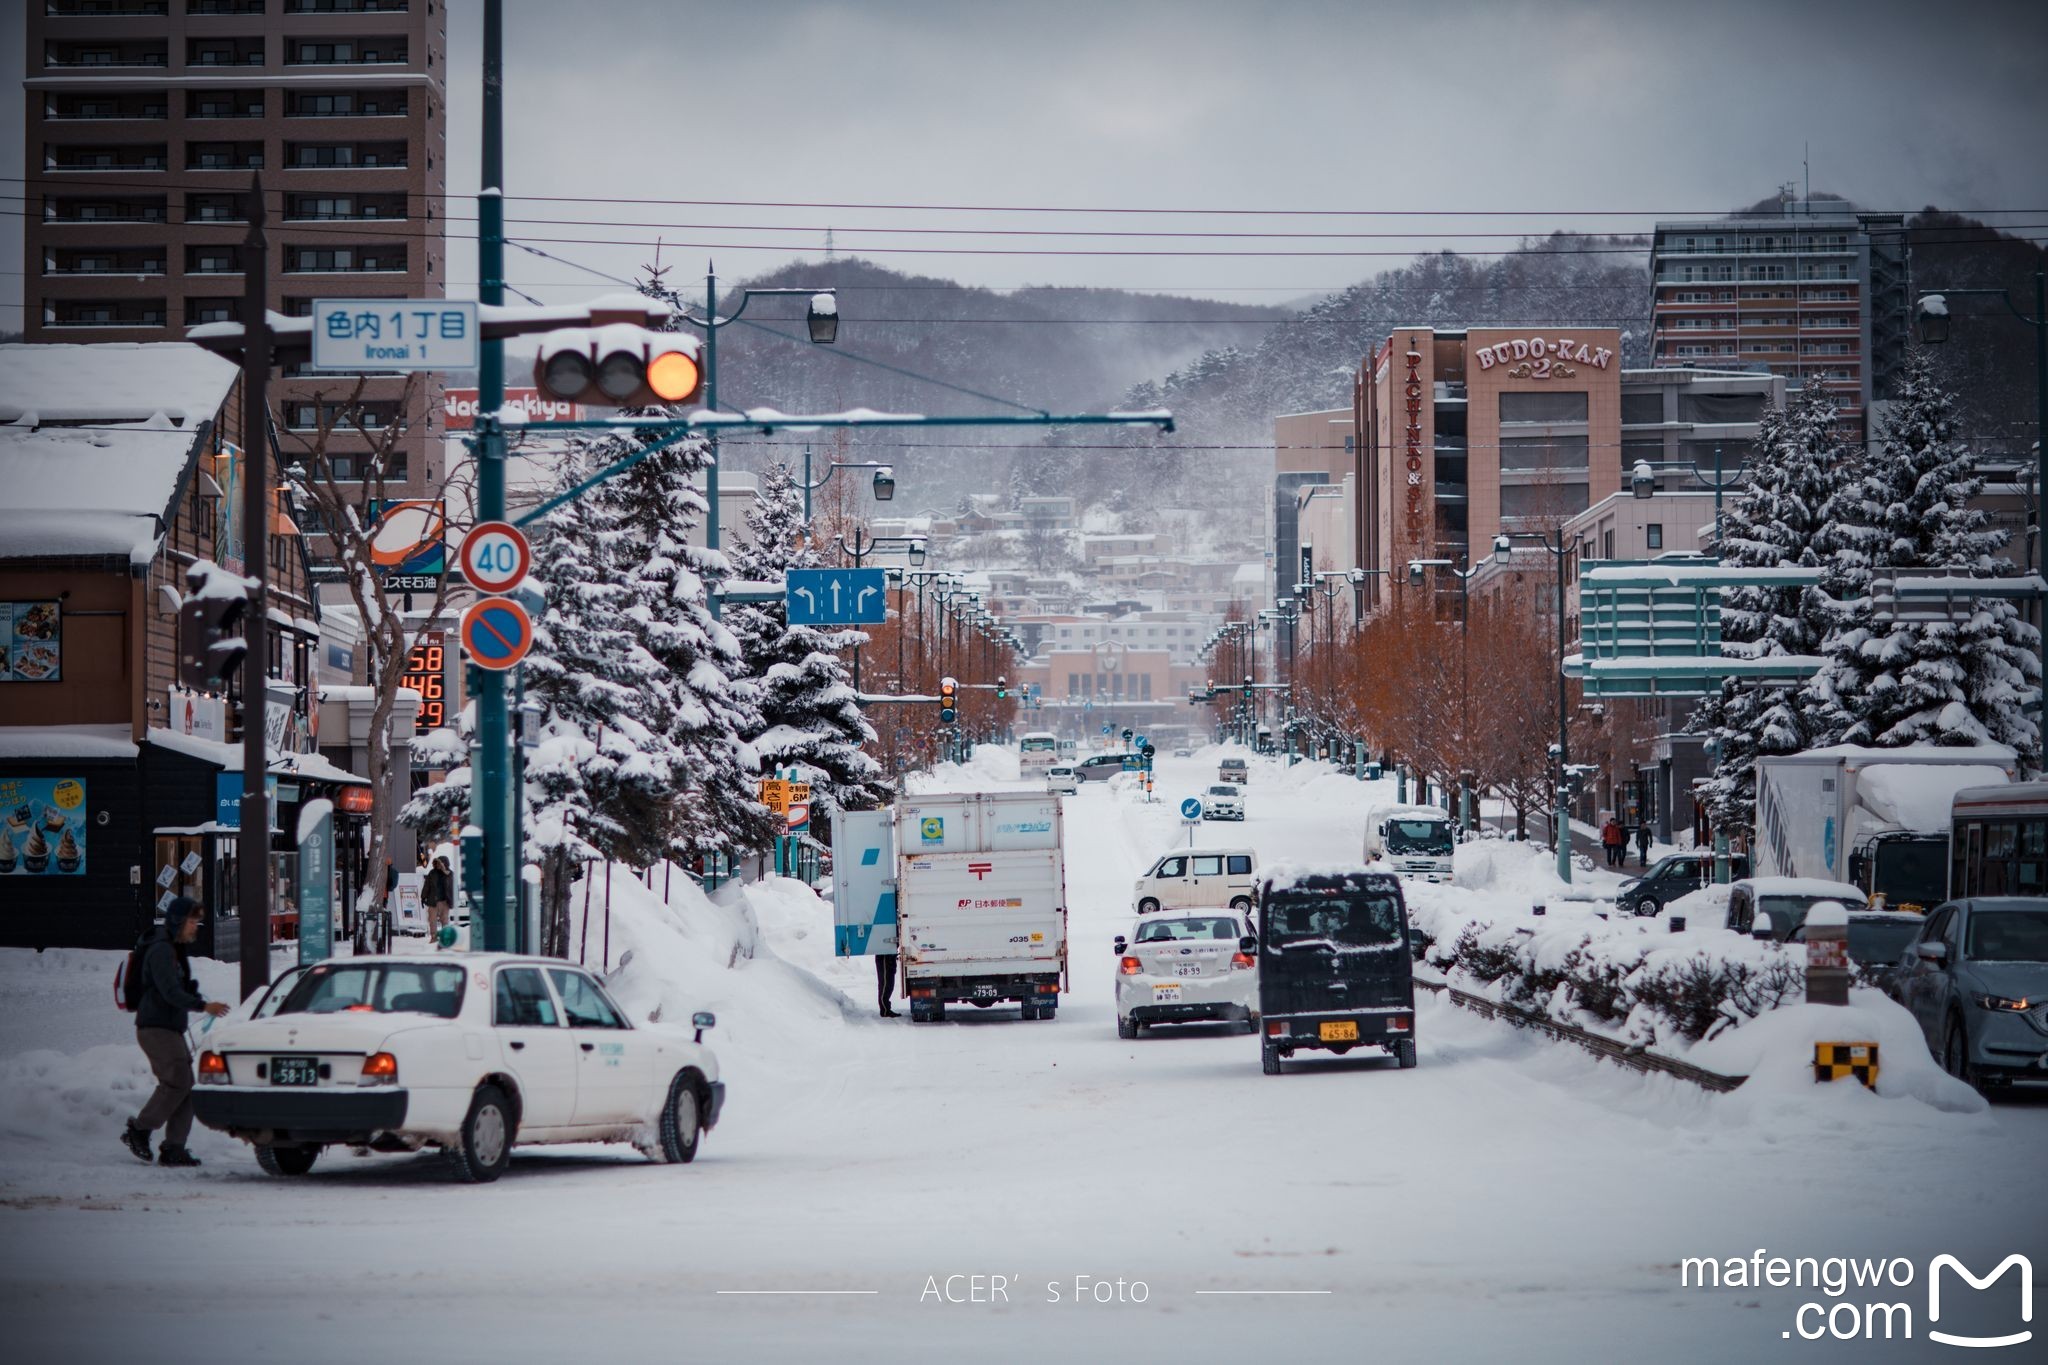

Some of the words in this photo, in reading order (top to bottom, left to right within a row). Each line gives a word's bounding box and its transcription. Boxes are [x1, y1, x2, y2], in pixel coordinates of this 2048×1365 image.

[326, 311, 465, 339] 色内1丁目
[366, 344, 409, 359] Ironai
[419, 345, 426, 359] 1
[1476, 337, 1612, 370] BUDO-KAN
[1532, 358, 1551, 379] 2
[445, 395, 571, 421] Naakiya
[1406, 351, 1422, 471] PACHINKO
[1407, 472, 1422, 485] &
[477, 543, 514, 572] 40
[280, 1068, 316, 1084] 58-13
